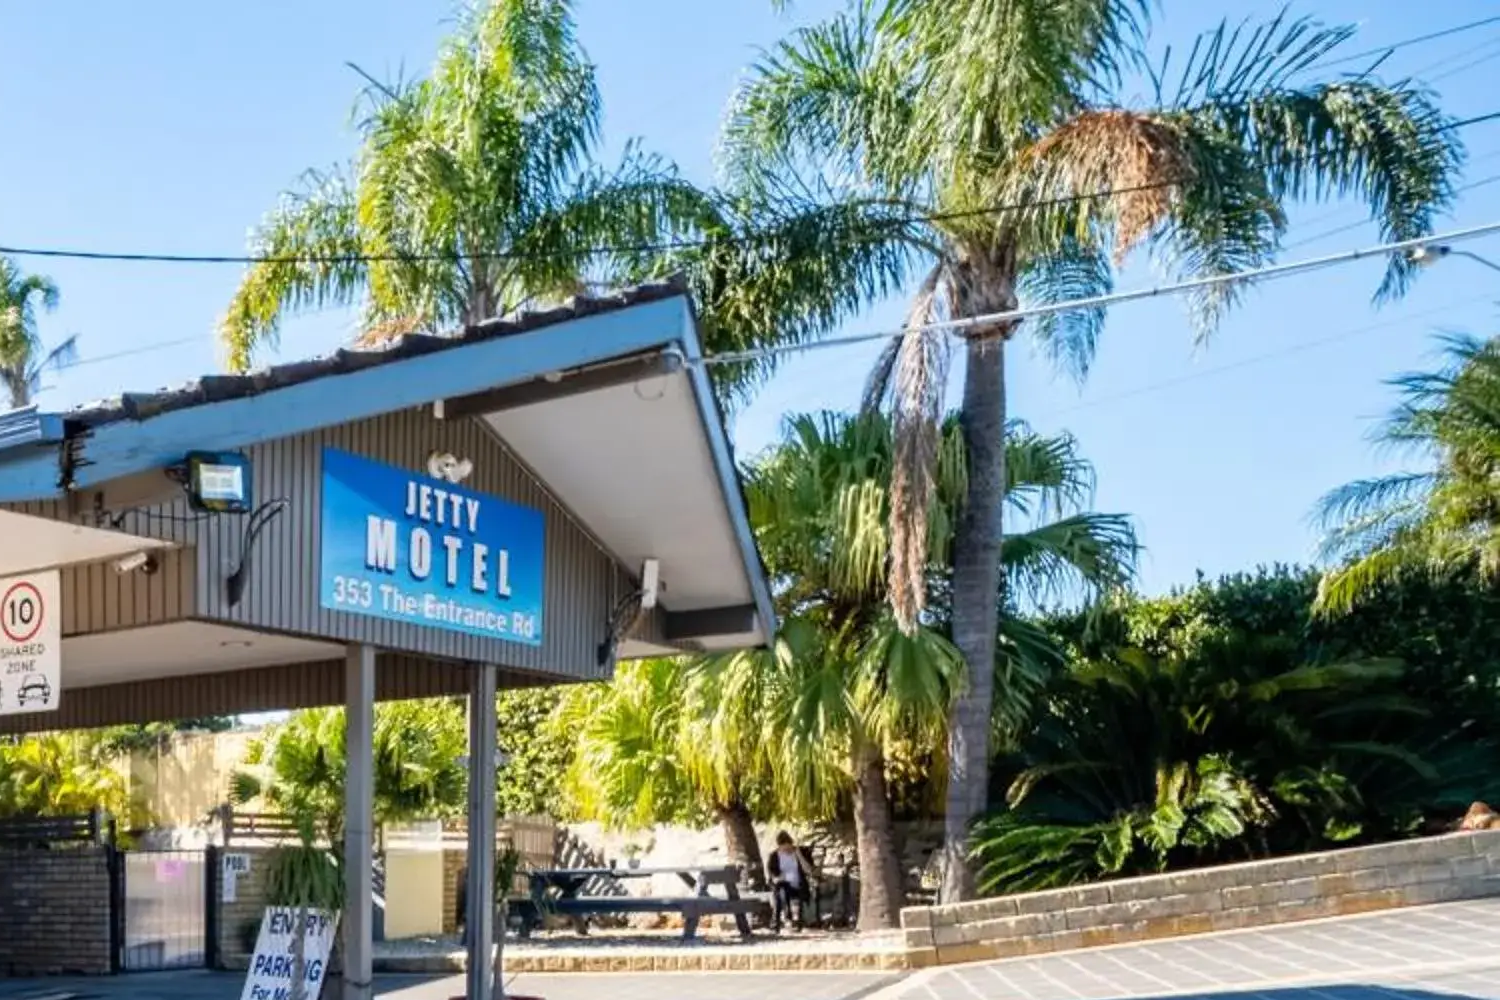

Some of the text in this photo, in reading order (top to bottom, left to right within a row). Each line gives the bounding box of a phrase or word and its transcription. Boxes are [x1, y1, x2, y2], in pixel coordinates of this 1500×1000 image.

[405, 480, 480, 533] JETTY
[366, 514, 511, 598] MOTEL
[9, 597, 34, 627] 10
[333, 575, 535, 638] 353 The Entrance Rd
[0, 643, 46, 660] SHARED
[6, 659, 37, 675] ZONE
[269, 912, 332, 937] ENRY
[250, 984, 271, 1000] For
